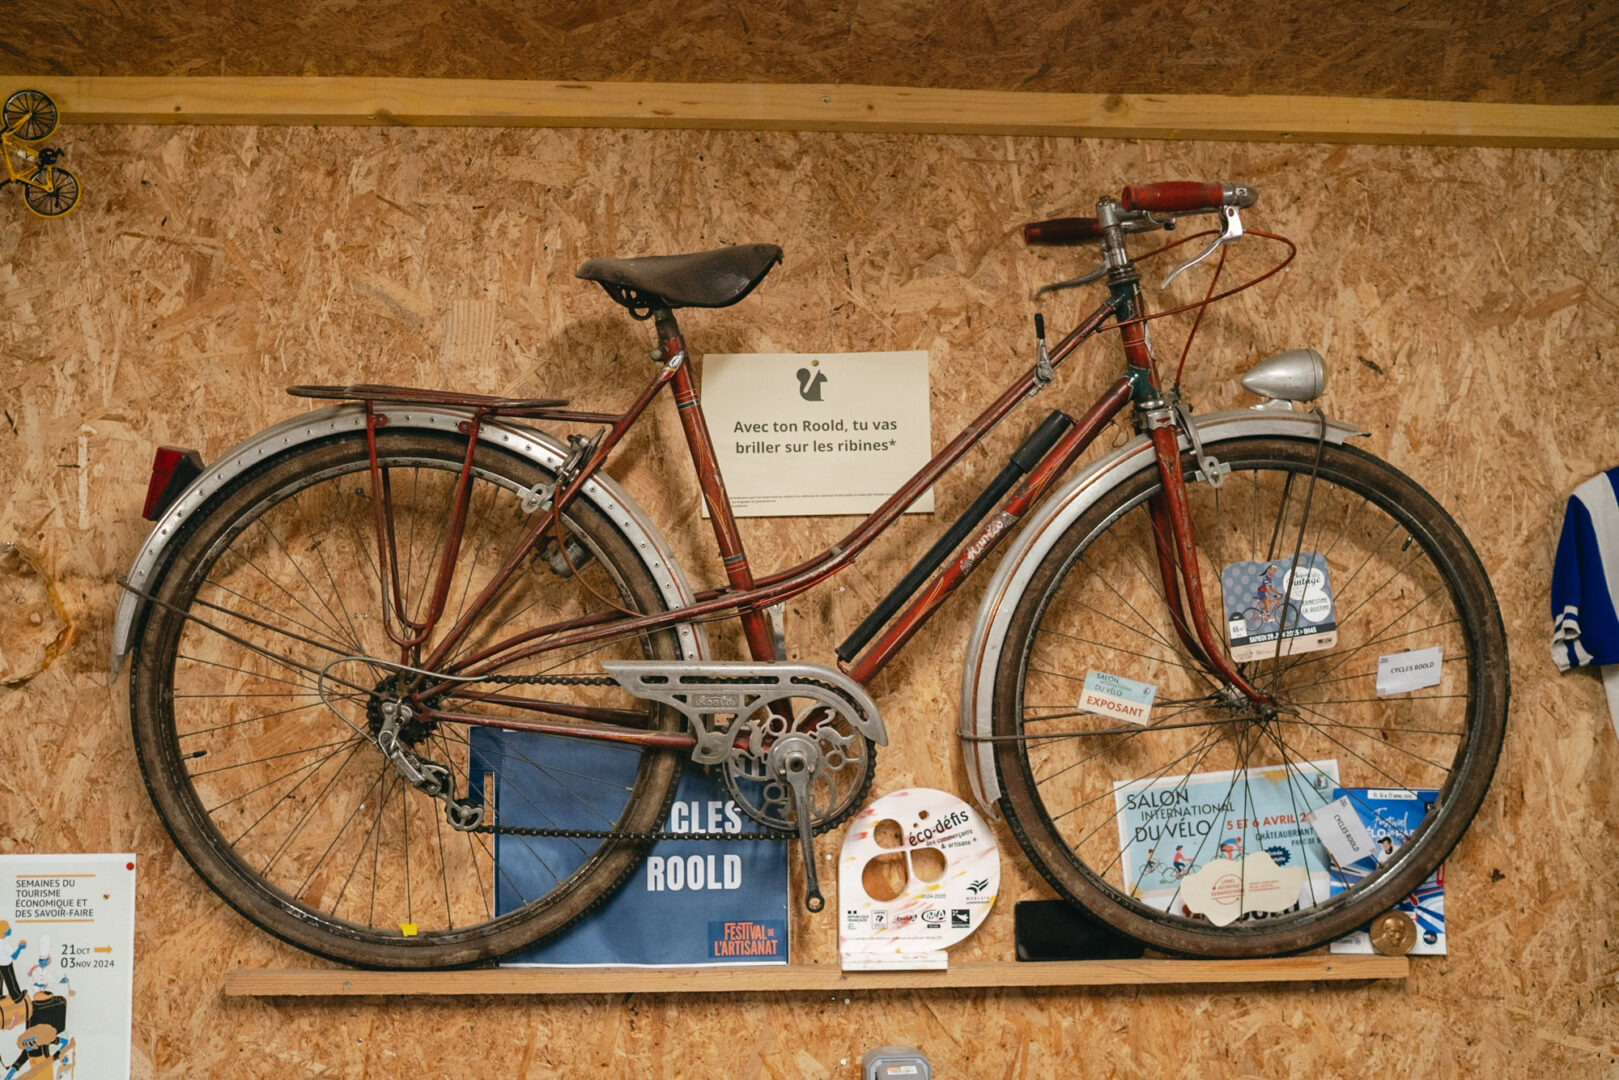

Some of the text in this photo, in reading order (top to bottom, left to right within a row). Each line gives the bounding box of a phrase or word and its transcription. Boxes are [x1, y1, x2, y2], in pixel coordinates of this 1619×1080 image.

[733, 419, 897, 433] Avec ton Roold, tu vas
[735, 441, 781, 454] briller
[785, 442, 809, 453] sur
[813, 440, 833, 452] les
[1390, 662, 1434, 674] CYCLES ROOLD
[1096, 672, 1120, 684] SALON
[1086, 696, 1144, 717] EXPOSANT
[1126, 788, 1190, 811] SALON
[669, 801, 742, 834] CLES
[1141, 803, 1236, 822] INTERNATIONAL
[909, 810, 969, 847] éco-défis
[1226, 820, 1234, 830] 5
[1237, 819, 1249, 829] ET
[1263, 814, 1296, 827] AVRIL
[1135, 818, 1212, 843] DU VÉLO
[1255, 827, 1314, 841] CHÂTEAUBRANT
[1333, 814, 1350, 834] CYCLES
[1344, 832, 1360, 853] ROOLD
[647, 854, 742, 891] ROOLD
[16, 879, 75, 888] SEMAINES DU
[16, 889, 61, 898] TOURISME
[15, 898, 88, 909] ÉCONOMIQUE ET
[15, 908, 94, 918] DES SAVOIR-FAIRE
[724, 922, 767, 940] FESTIVAL
[714, 940, 778, 956] L'ARTISANAT
[93, 960, 115, 968] 2024
